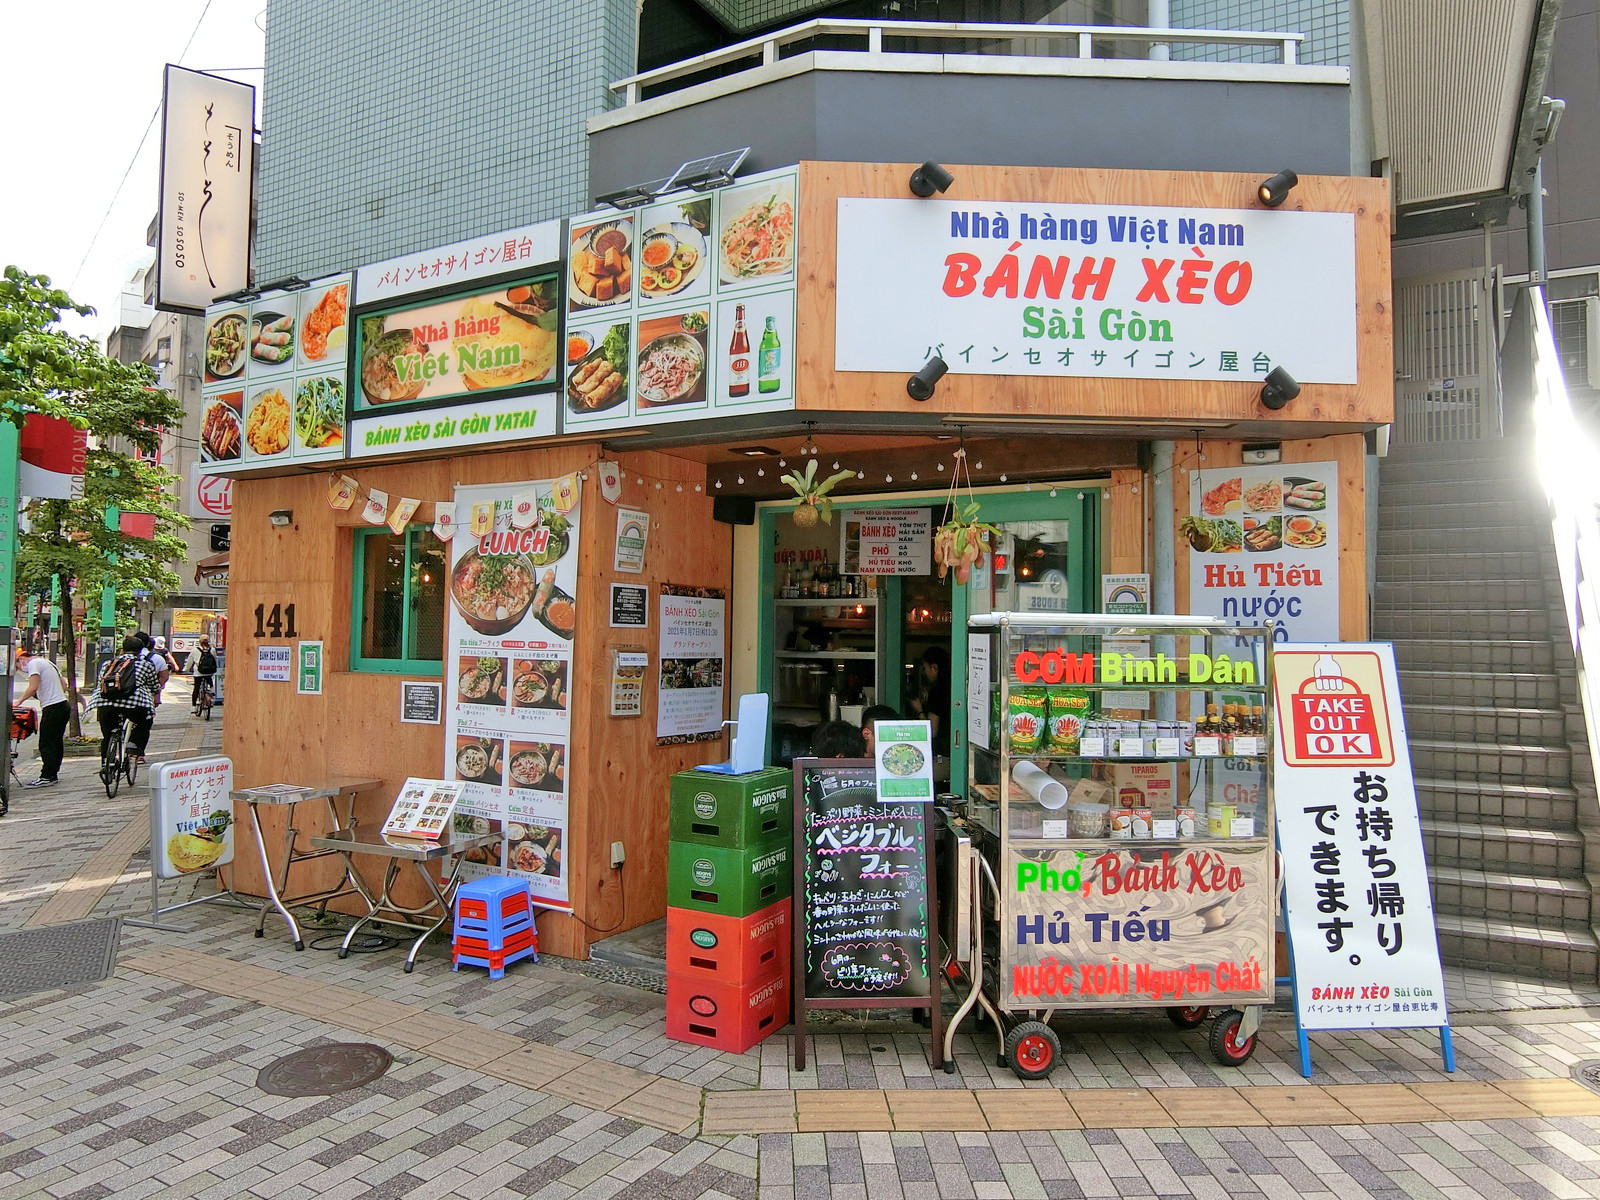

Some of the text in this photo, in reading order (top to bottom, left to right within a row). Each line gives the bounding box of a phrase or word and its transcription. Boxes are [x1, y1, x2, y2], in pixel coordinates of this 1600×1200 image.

[226, 133, 234, 168] そうめん
[951, 210, 1245, 250] Nhà hàng Việt Nam
[377, 236, 533, 288] バインセオサイゴン屋台
[941, 240, 1254, 308] BÁNH XÈO
[412, 315, 501, 346] Nhà hàng
[1022, 306, 1174, 342] Sài Gòn
[393, 342, 522, 387] Việt Nam
[922, 343, 1272, 374] バインセオサイゴン屋台
[365, 409, 537, 447] BÁNH XÈO SÀI GÒN YATAI
[478, 530, 550, 555] LUNCH
[861, 523, 896, 537] BÁNH XÈO
[1204, 562, 1323, 587] Hủ Tiếu
[1223, 590, 1303, 618] nước
[254, 603, 297, 638] 141
[1014, 646, 1254, 684] CƠM Bình Dân
[1052, 696, 1089, 708] HOA SEN
[1300, 698, 1365, 713] TAKE
[1309, 715, 1361, 731] OUT
[1315, 735, 1364, 754] OK
[170, 763, 229, 779] BÁNH XÈO SÀI GÒN
[1131, 766, 1158, 774] TIPAROS
[173, 774, 226, 793] バインセオ
[179, 789, 222, 806] サイゴン
[189, 802, 211, 818] 屋台
[752, 791, 777, 808] SAIGON
[200, 816, 225, 829] Nam
[815, 822, 915, 849] ベジタブル
[752, 855, 777, 874] SAIGON
[859, 854, 909, 874] フォー
[1096, 852, 1179, 896] Bánh
[1186, 852, 1245, 894] Xèo
[1353, 771, 1404, 956] お持ち帰り
[1303, 804, 1361, 966] できます。
[750, 919, 774, 940] SAIGON
[1016, 905, 1170, 945] Hủ Tiếu
[1013, 955, 1261, 1000] NƯỚC XOÀI Nguyên Chất
[749, 984, 773, 1008] SAIGON
[1311, 982, 1433, 1000] BÁNH XÈO Sài Gòn
